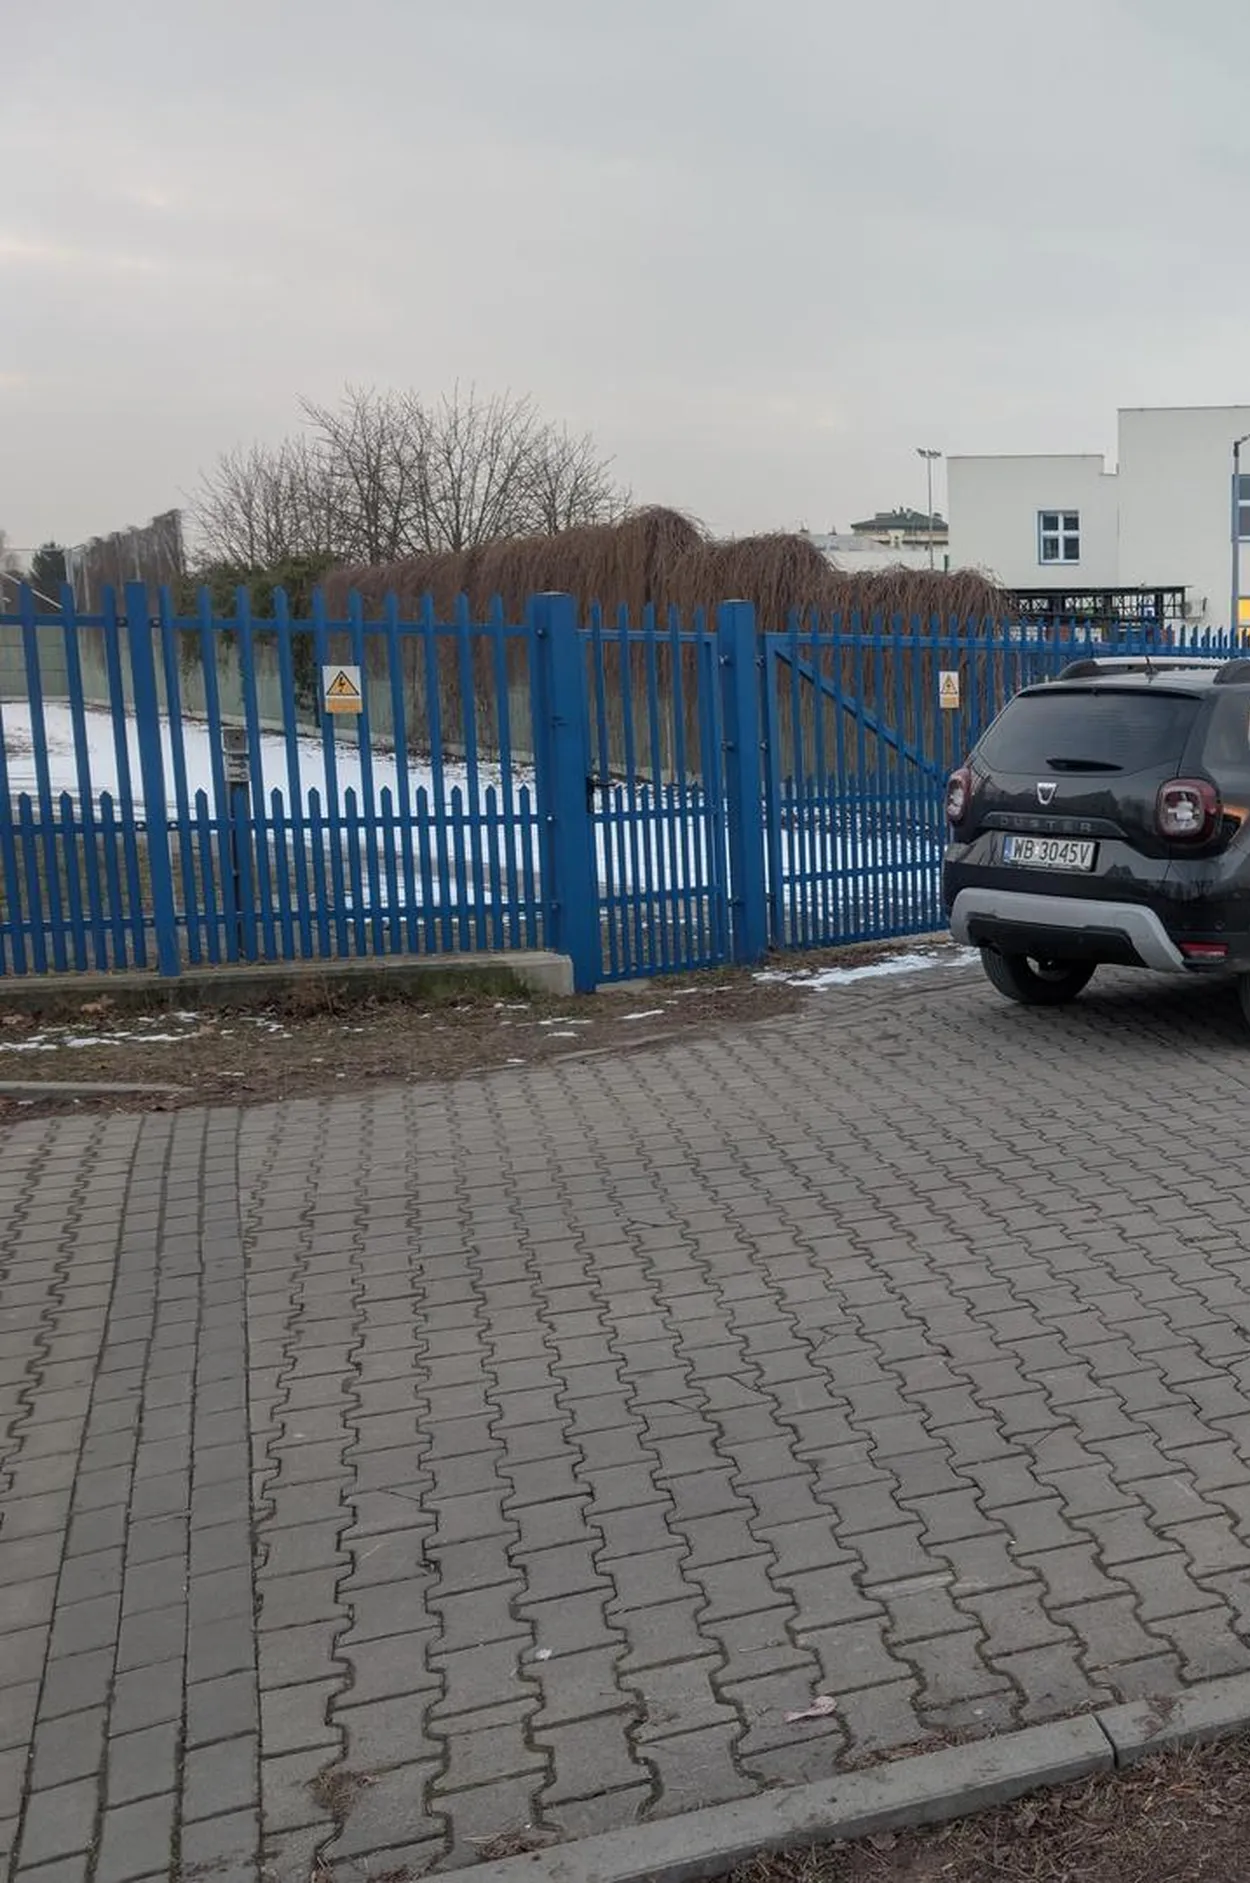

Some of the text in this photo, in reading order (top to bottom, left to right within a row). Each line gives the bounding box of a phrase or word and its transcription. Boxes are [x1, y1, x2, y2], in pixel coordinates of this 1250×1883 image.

[1000, 816, 1092, 832] DUSTER
[1014, 838, 1091, 864] WB 3045V
